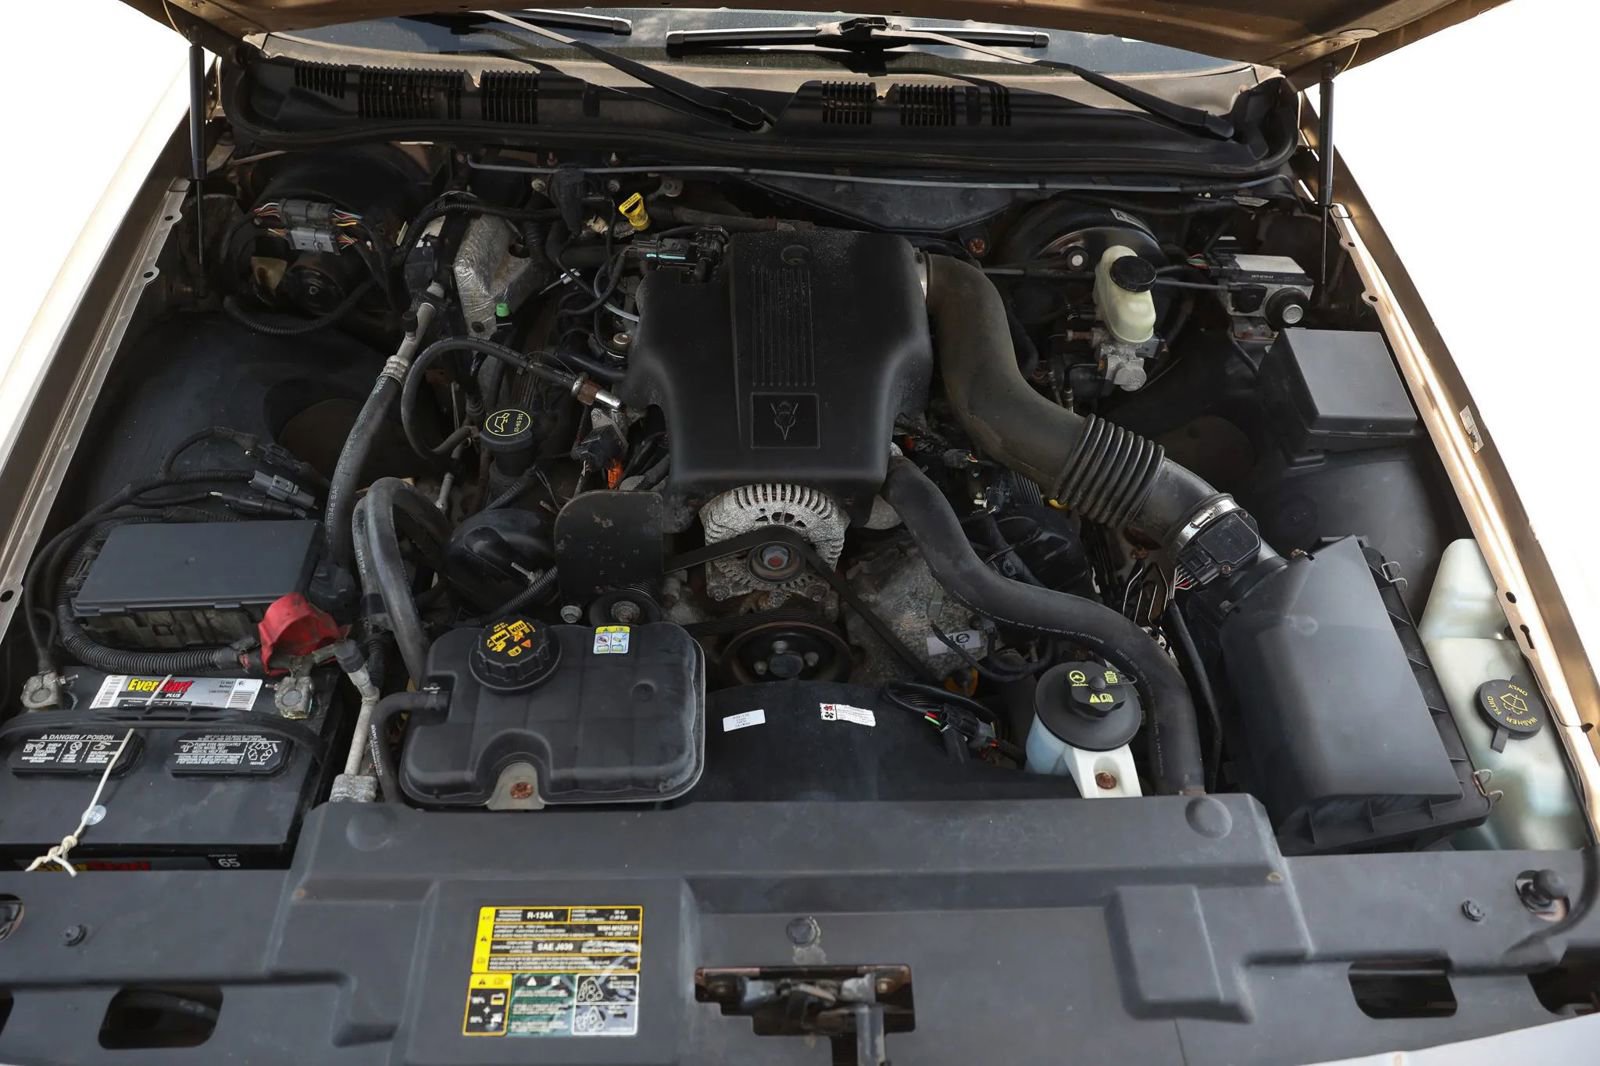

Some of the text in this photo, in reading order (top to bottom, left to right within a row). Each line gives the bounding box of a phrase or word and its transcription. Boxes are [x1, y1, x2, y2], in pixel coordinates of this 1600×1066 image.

[1487, 684, 1537, 727] WASHER FLUID ONLY
[218, 858, 240, 868] 65
[526, 911, 555, 920] R-134A
[537, 942, 555, 951] SAE
